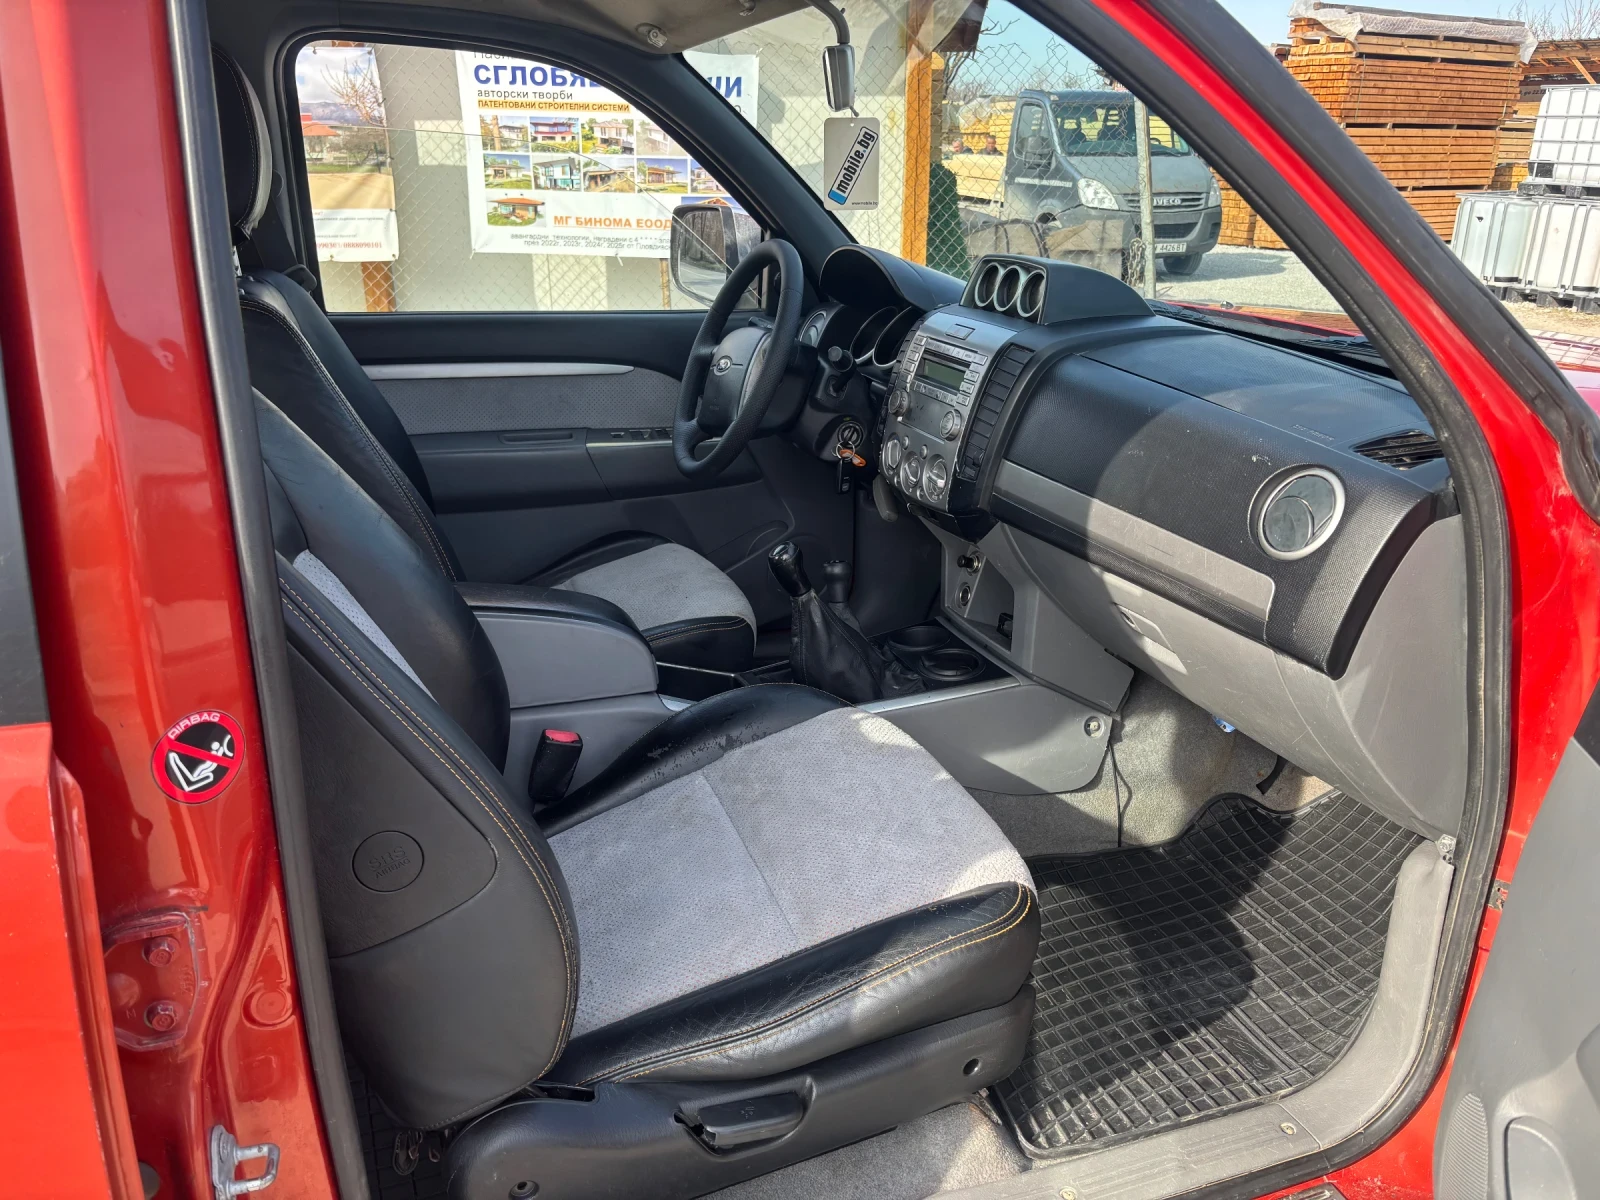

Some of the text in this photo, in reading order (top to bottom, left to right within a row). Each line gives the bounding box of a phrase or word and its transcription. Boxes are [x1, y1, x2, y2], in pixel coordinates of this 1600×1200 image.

[477, 89, 573, 101] авторски творби
[478, 100, 630, 111] ПАТЕНТОВАНИ СТРОИТЕЛНИ СИСТЕМИ
[836, 131, 876, 194] mobile.bg
[1153, 197, 1181, 206] IVECO
[553, 215, 672, 231] МГ БИНОМА ЕООД
[167, 712, 221, 740] AIRBAG
